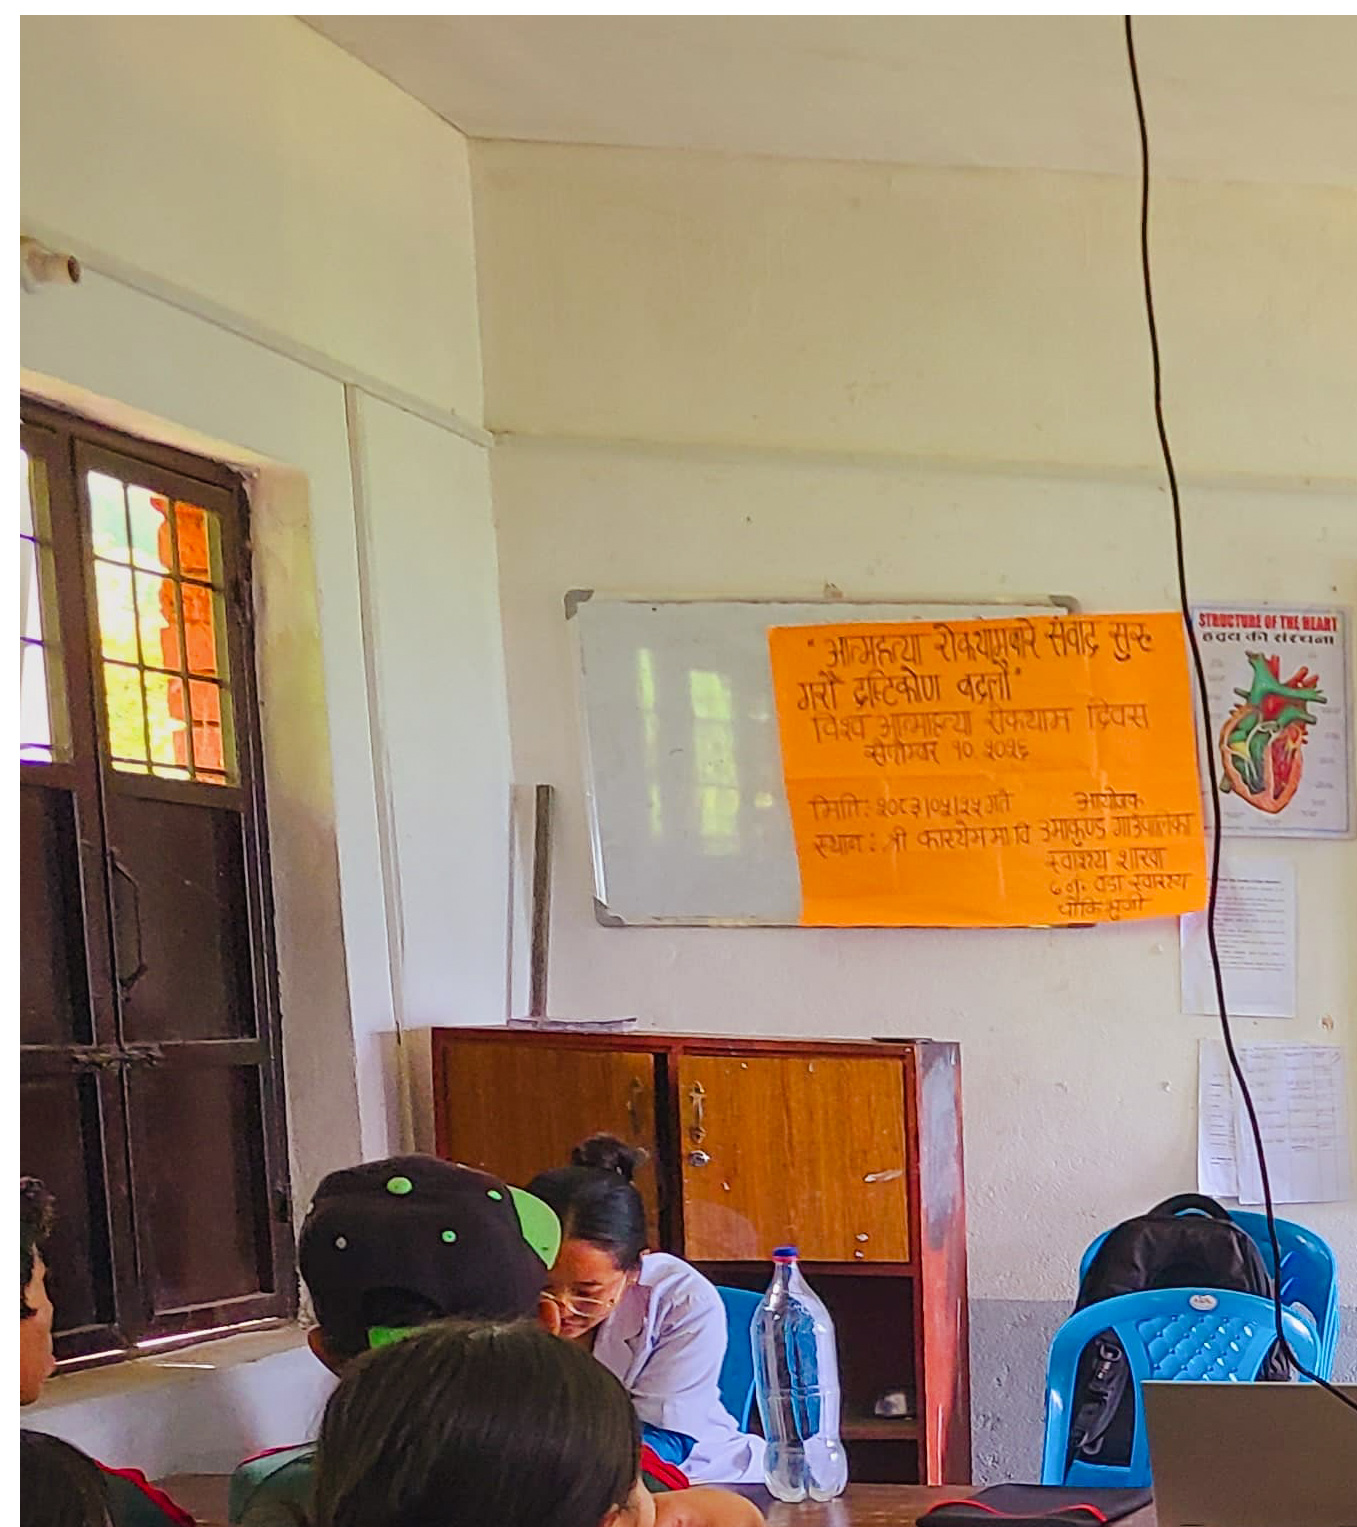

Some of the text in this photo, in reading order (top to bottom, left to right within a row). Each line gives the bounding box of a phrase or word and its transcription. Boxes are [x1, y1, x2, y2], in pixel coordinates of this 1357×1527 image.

[1198, 613, 1337, 631] STRUCTURE OF THE HEART
